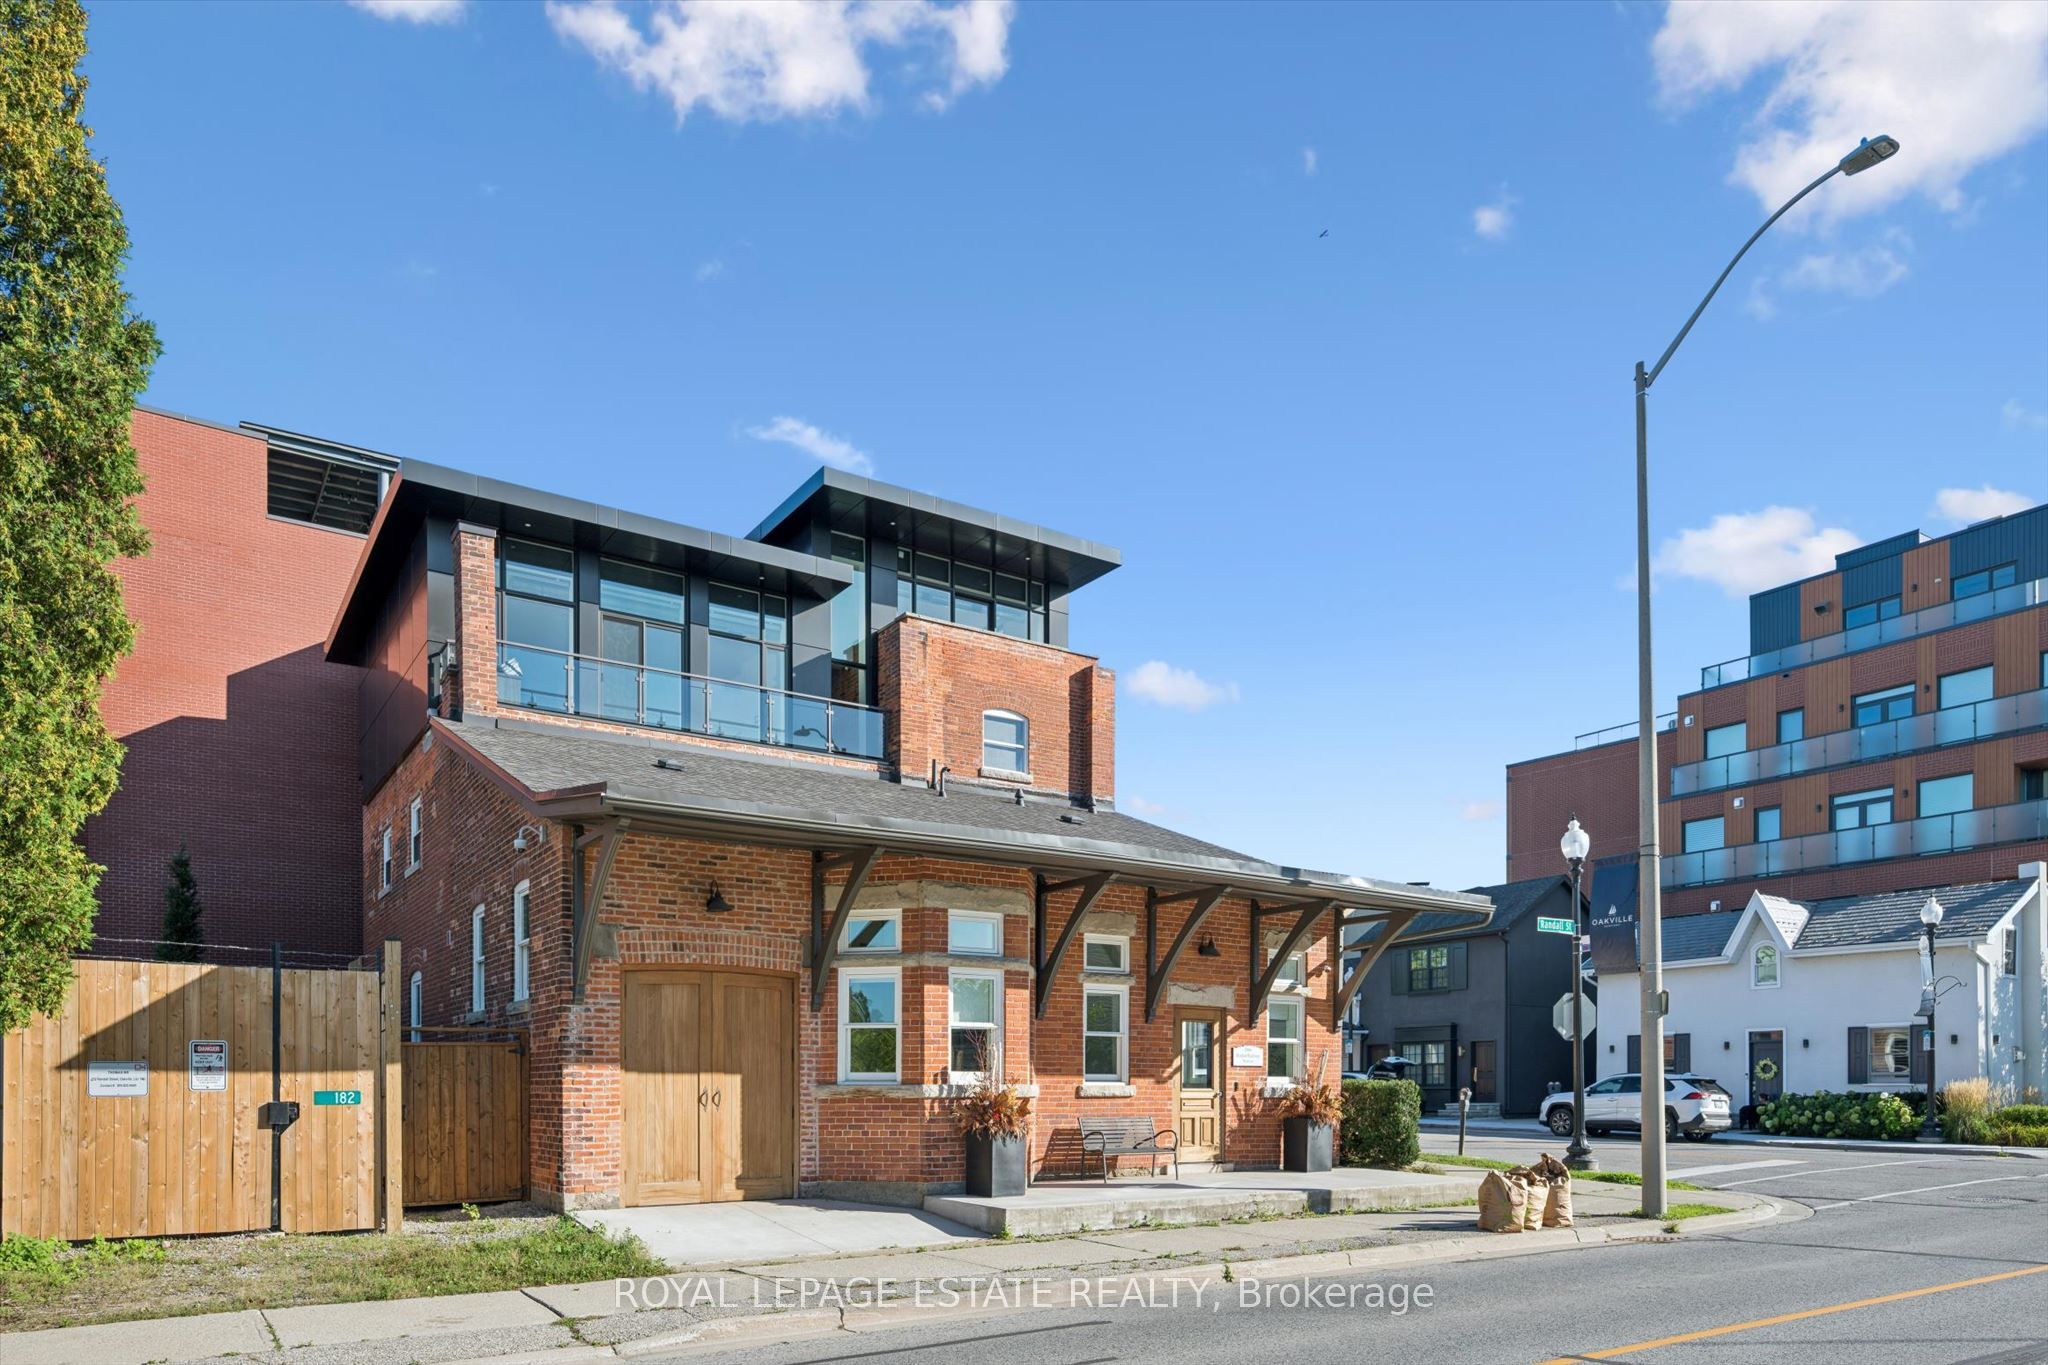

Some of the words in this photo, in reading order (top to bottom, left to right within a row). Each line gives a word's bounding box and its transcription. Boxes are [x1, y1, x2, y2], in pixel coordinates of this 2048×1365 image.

[1540, 919, 1564, 931] Randall
[1591, 914, 1633, 926] OAKVILLE
[335, 1091, 355, 1104] 182
